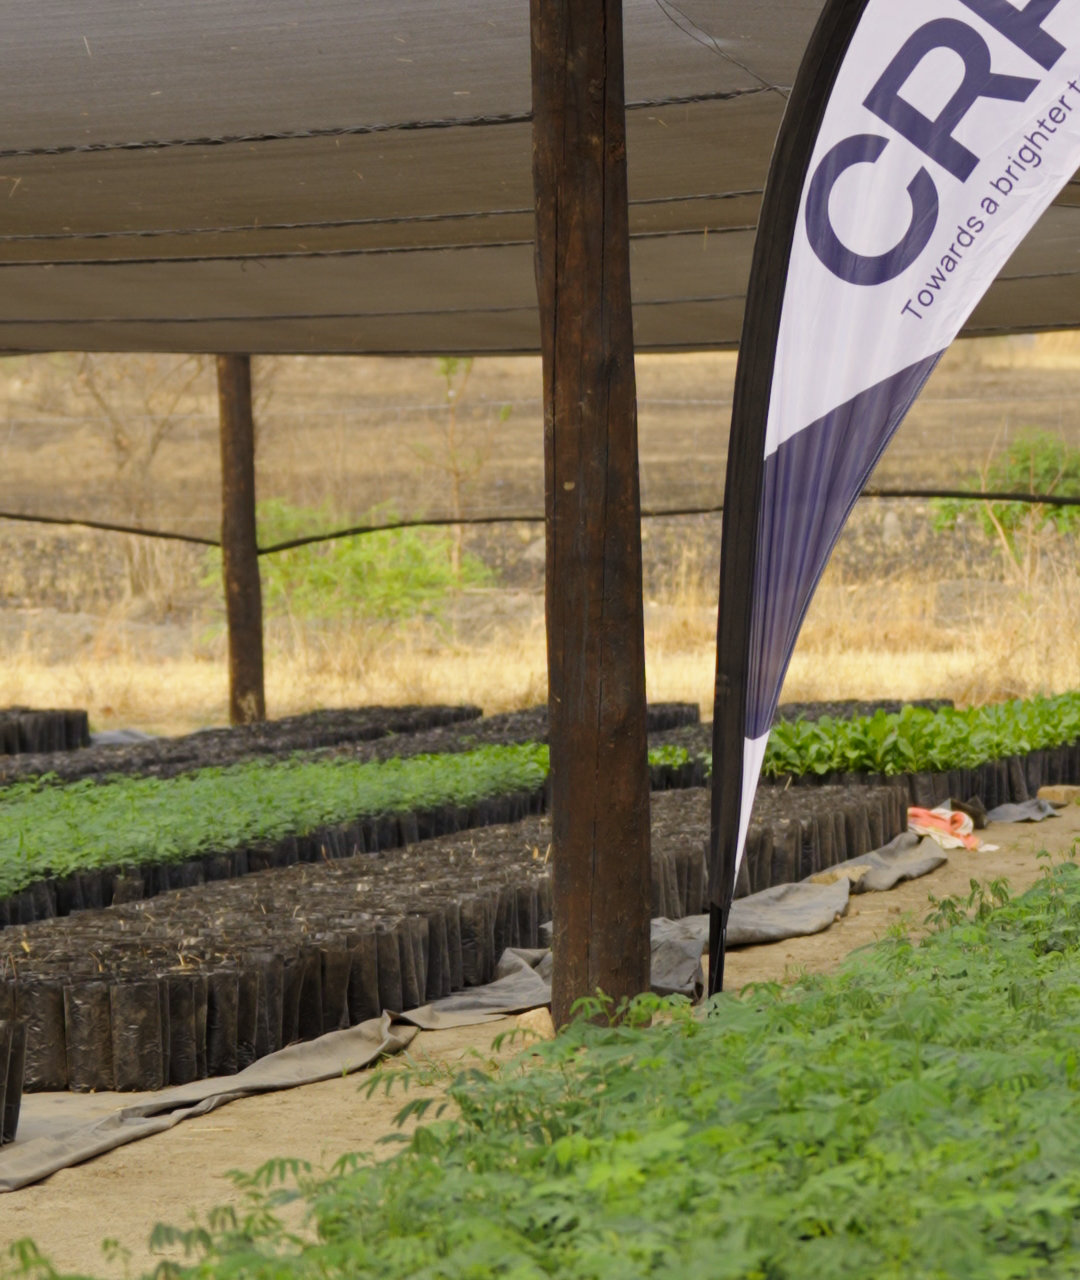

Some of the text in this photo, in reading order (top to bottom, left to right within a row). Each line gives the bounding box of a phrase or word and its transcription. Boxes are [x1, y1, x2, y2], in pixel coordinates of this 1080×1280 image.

[989, 94, 1073, 197] brighter
[980, 196, 1000, 215] a
[900, 215, 985, 320] Towards
